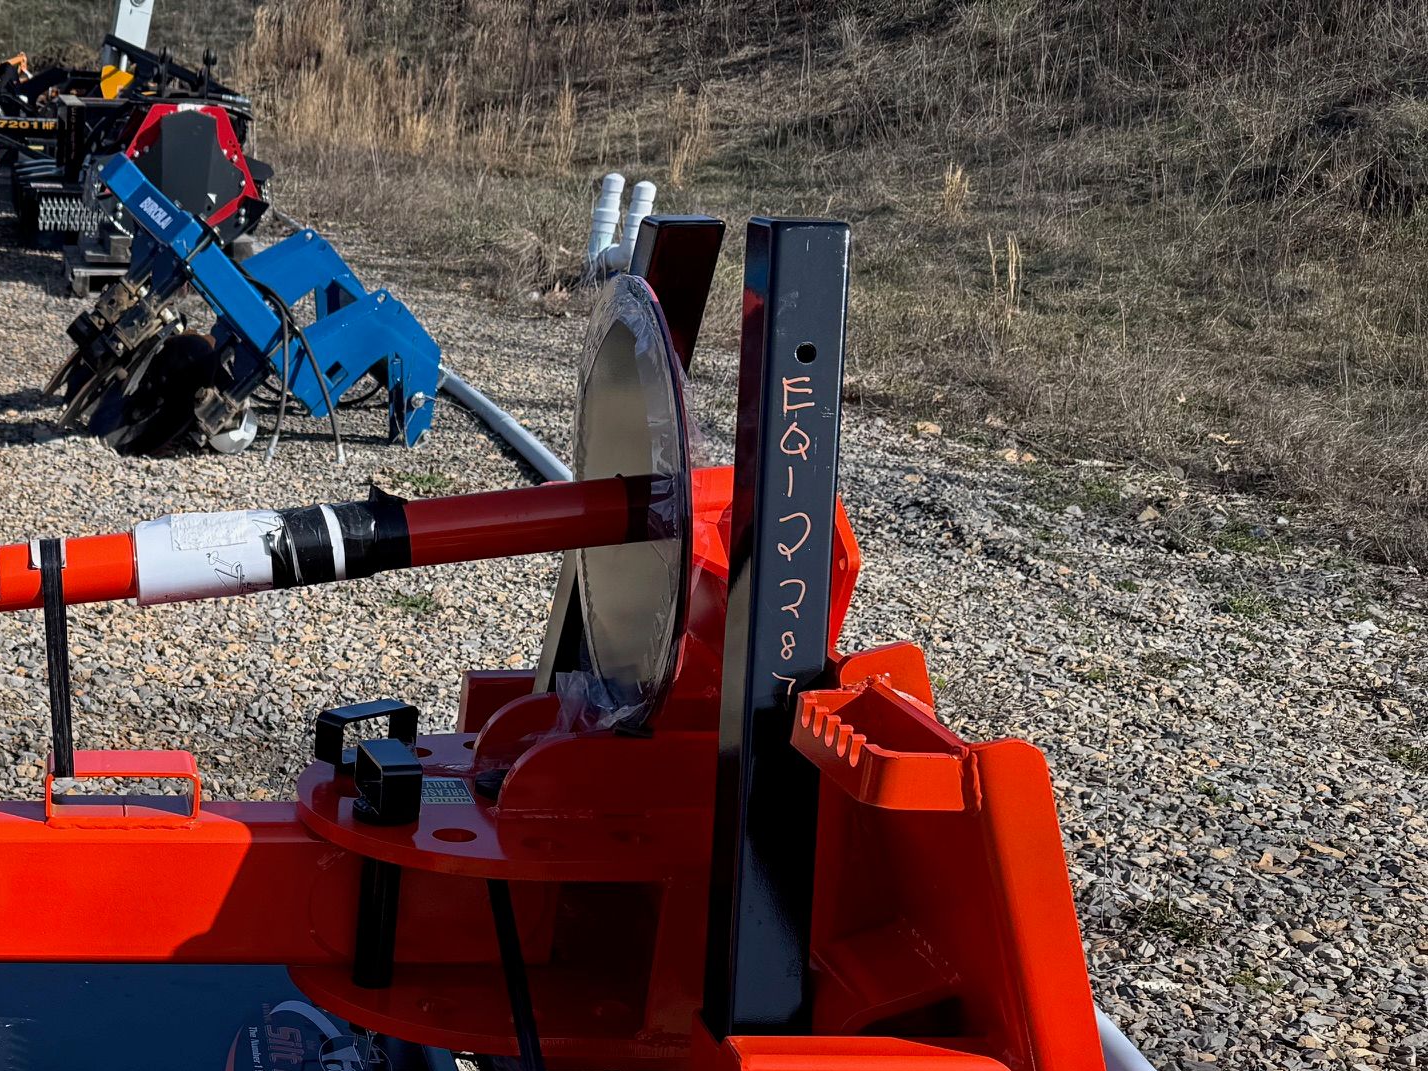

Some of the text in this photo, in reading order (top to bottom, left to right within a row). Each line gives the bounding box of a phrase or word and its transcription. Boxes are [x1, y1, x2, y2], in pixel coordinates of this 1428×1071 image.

[42, 121, 57, 130] HF
[422, 789, 468, 797] GREASE
[248, 1026, 258, 1038] The
[265, 1024, 305, 1065] Silt
[251, 1038, 263, 1064] Number
